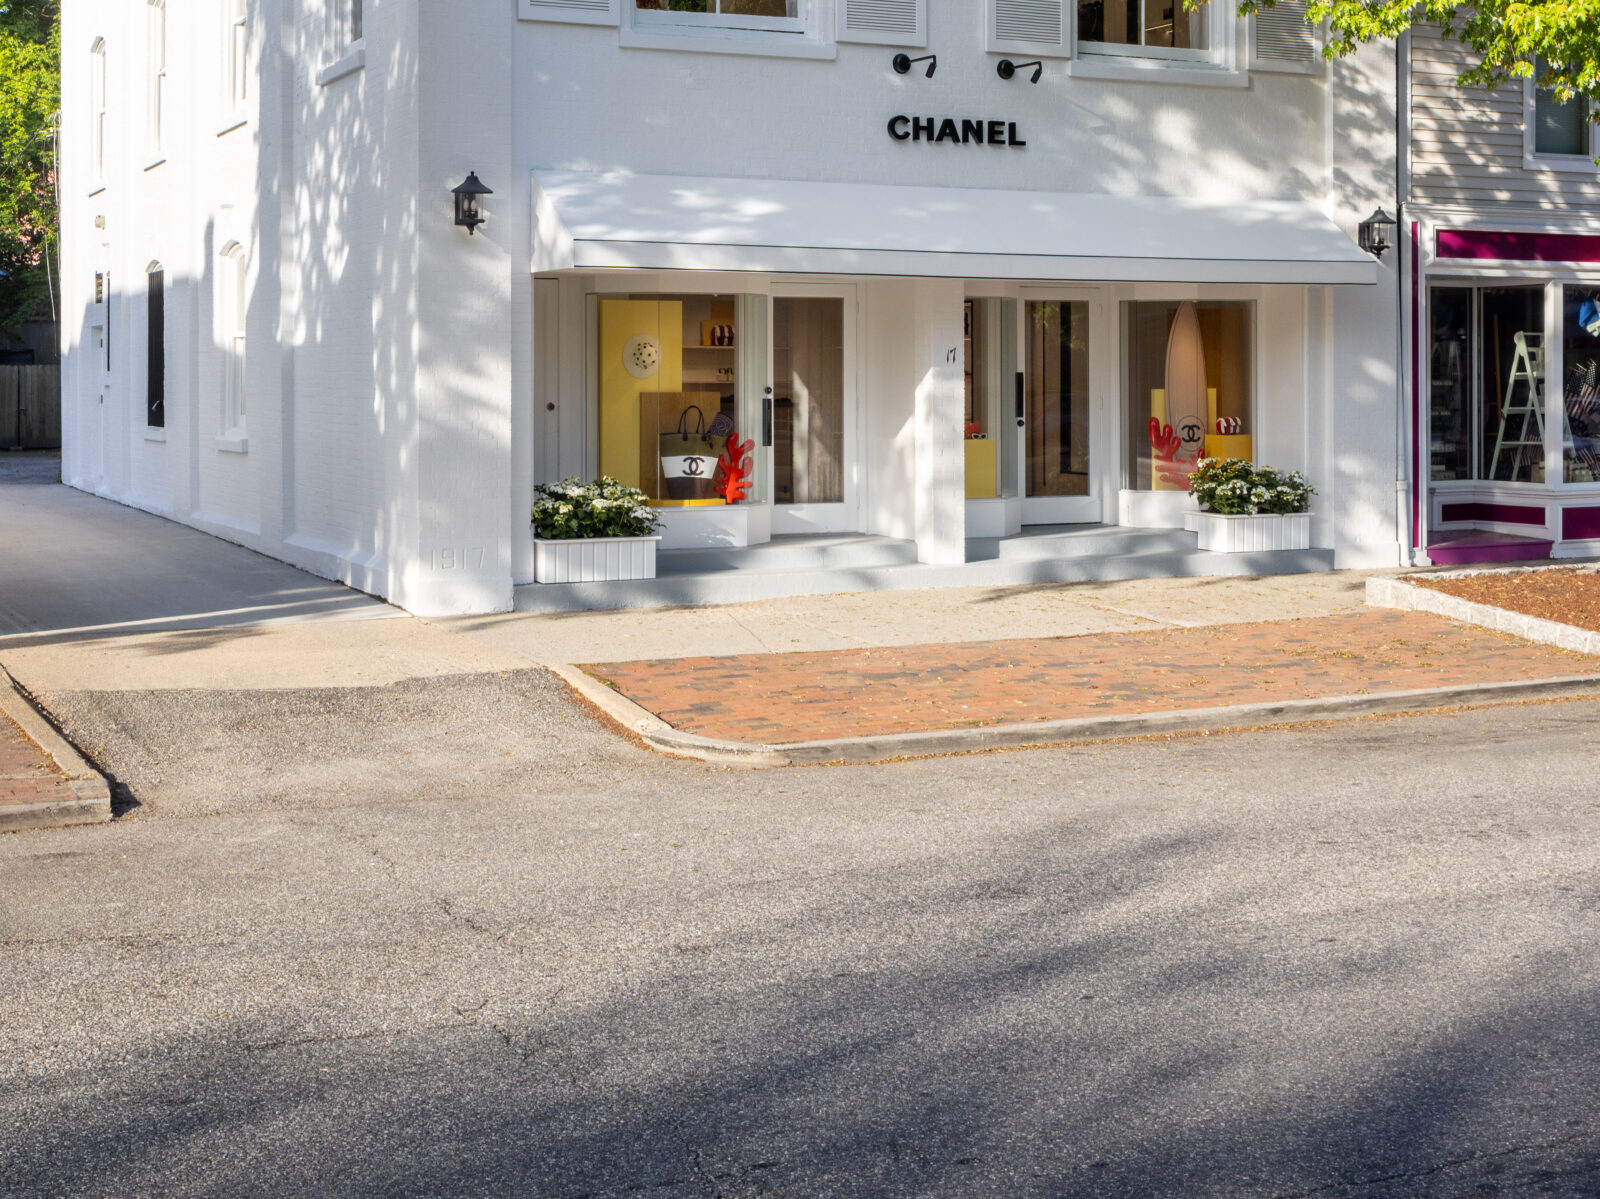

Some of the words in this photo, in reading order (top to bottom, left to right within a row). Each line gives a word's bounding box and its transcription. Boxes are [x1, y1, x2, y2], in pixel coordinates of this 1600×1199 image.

[887, 115, 1026, 146] CHANEL
[946, 346, 957, 364] 17
[431, 544, 487, 570] 1917
